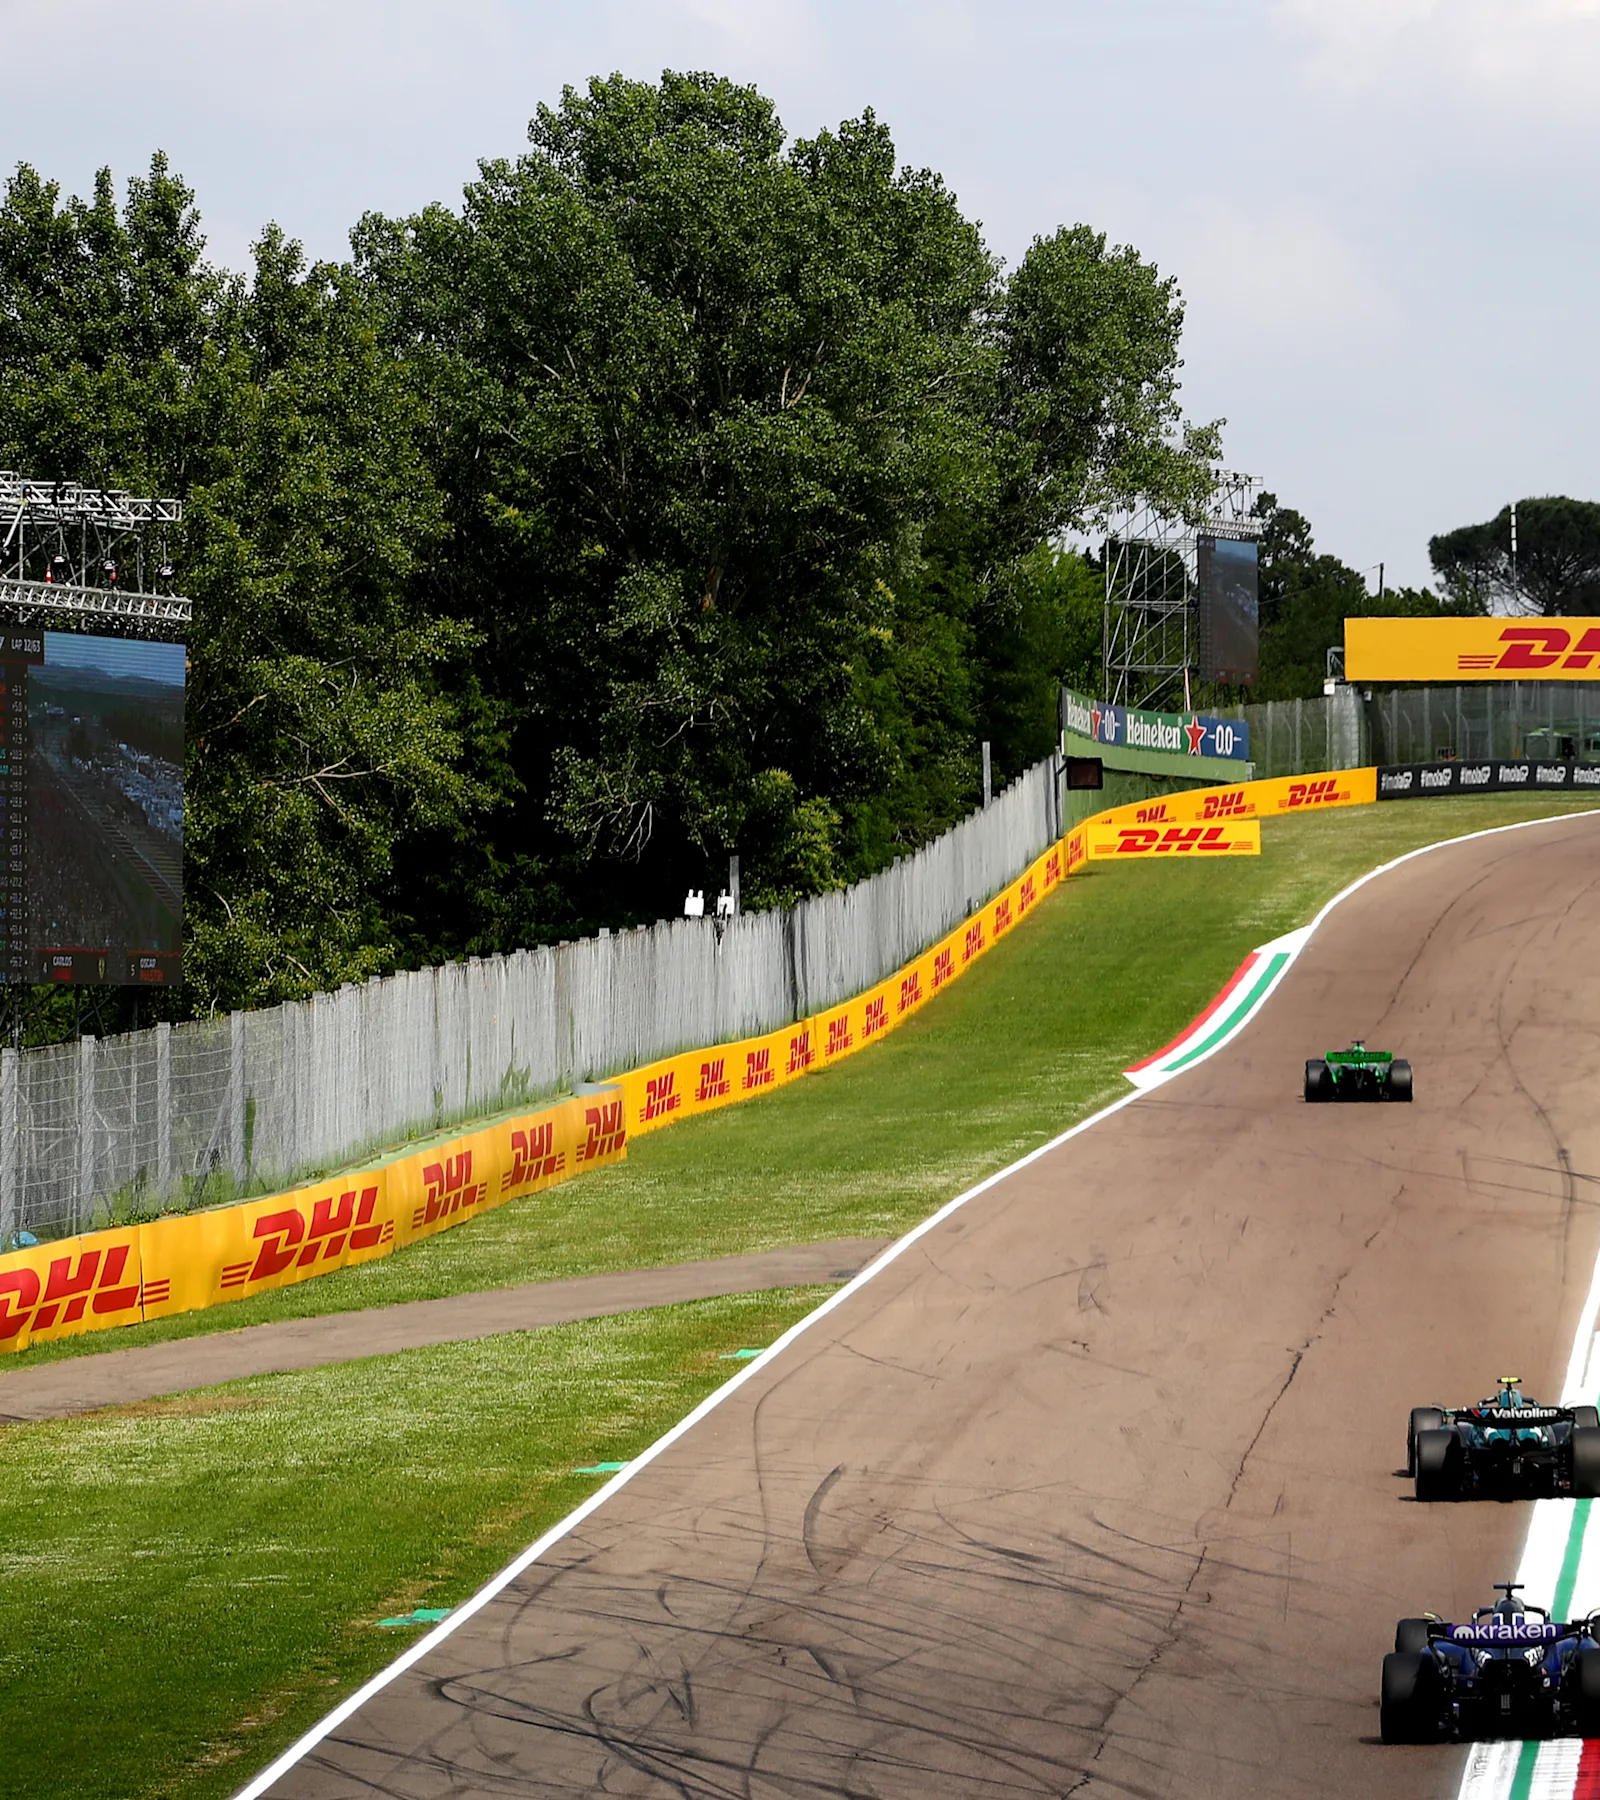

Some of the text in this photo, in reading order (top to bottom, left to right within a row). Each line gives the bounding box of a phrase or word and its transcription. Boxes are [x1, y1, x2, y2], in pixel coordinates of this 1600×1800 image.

[1215, 724, 1234, 756] 0.0
[1202, 791, 1247, 819] DHL
[1287, 778, 1340, 807] DHL
[1116, 827, 1232, 853] DHL
[139, 957, 157, 969] OSCAR
[900, 971, 919, 1013] DHL
[829, 1015, 850, 1056] DHL
[865, 995, 885, 1038] DHL
[747, 1048, 771, 1089] DHL
[789, 1030, 811, 1073] DHL
[645, 1071, 675, 1121] DHL
[699, 1058, 725, 1101] DHL
[584, 1100, 626, 1161] DHL
[509, 1122, 557, 1187] DHL
[422, 1150, 478, 1227] DHL
[248, 1186, 386, 1282] DHL
[1491, 1407, 1558, 1419] Valvoline
[1475, 1623, 1557, 1640] kraken
